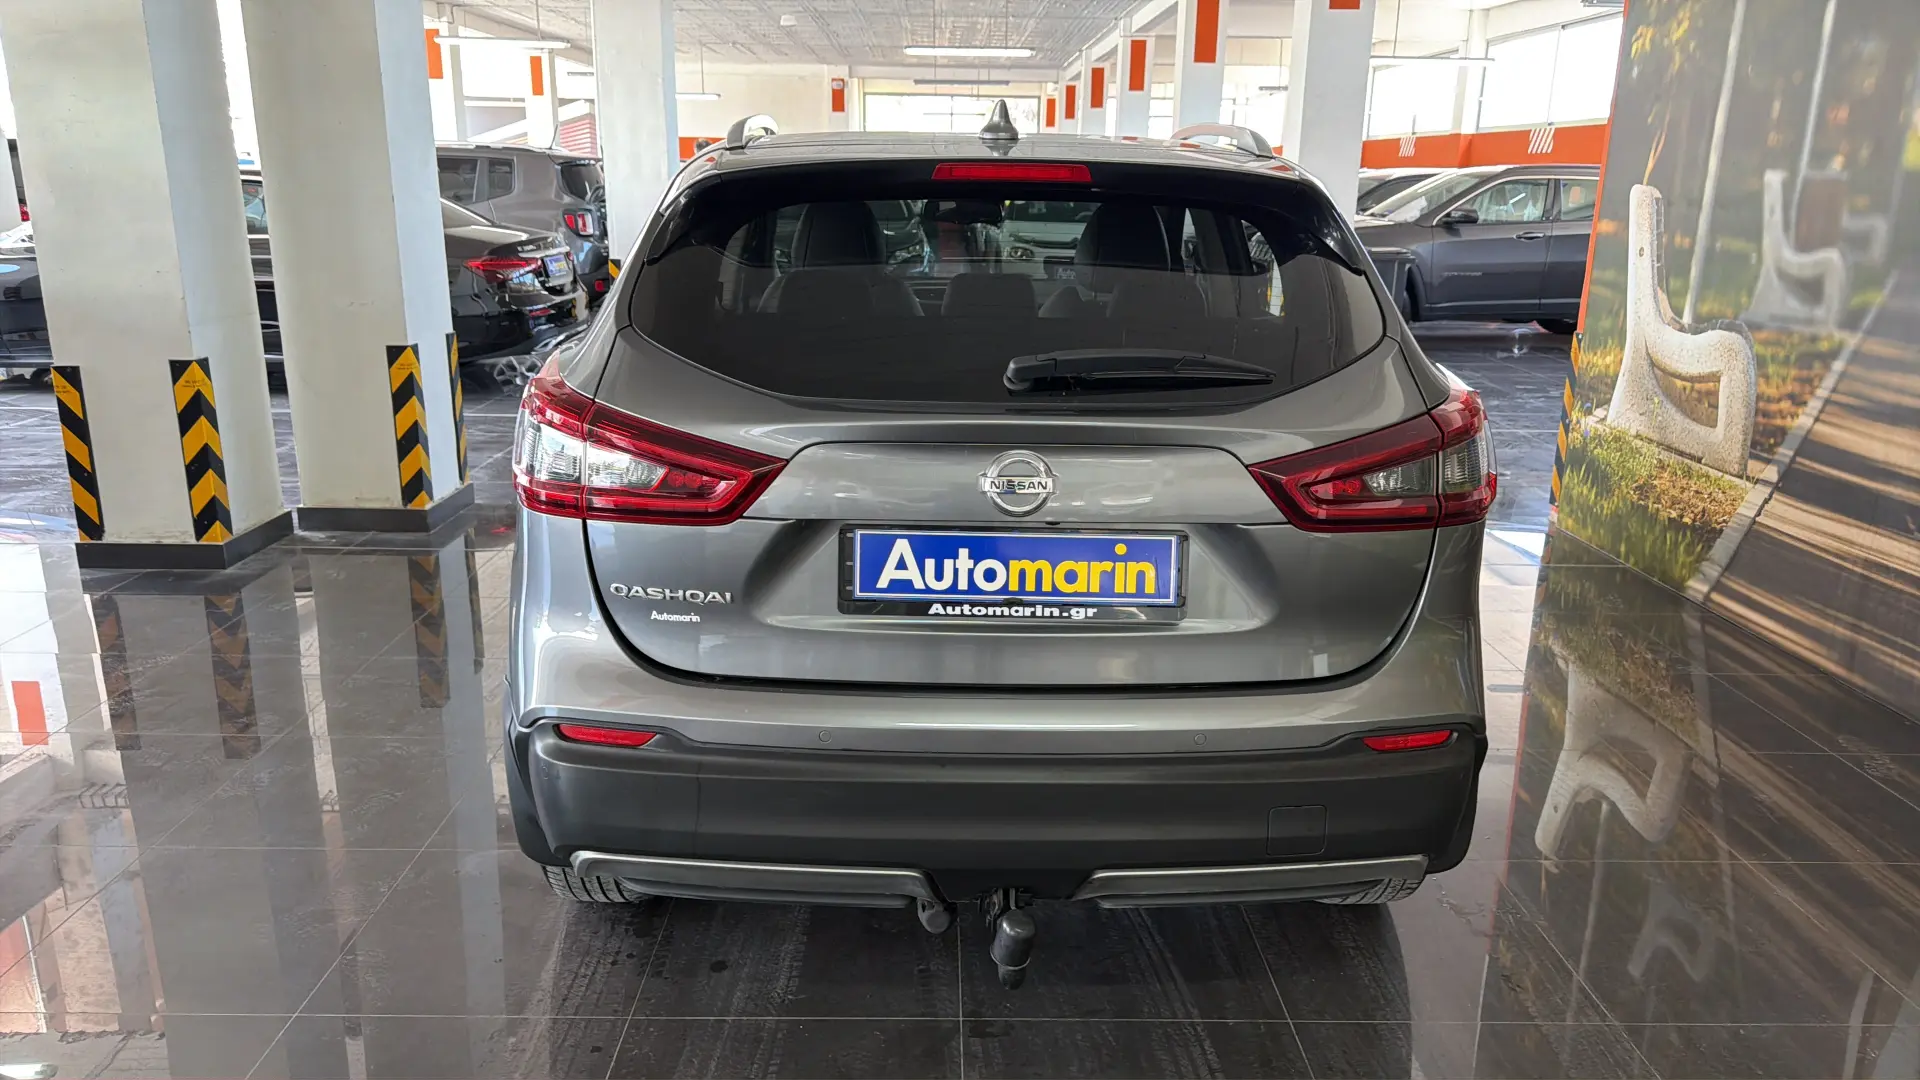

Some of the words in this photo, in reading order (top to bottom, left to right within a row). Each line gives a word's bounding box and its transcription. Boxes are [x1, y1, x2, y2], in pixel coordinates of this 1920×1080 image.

[990, 480, 1048, 490] NISSAN
[876, 538, 1156, 594] Automarin
[609, 583, 732, 606] QASHQAI
[650, 610, 701, 622] Automarin
[928, 603, 1098, 620] Automarin.gr
